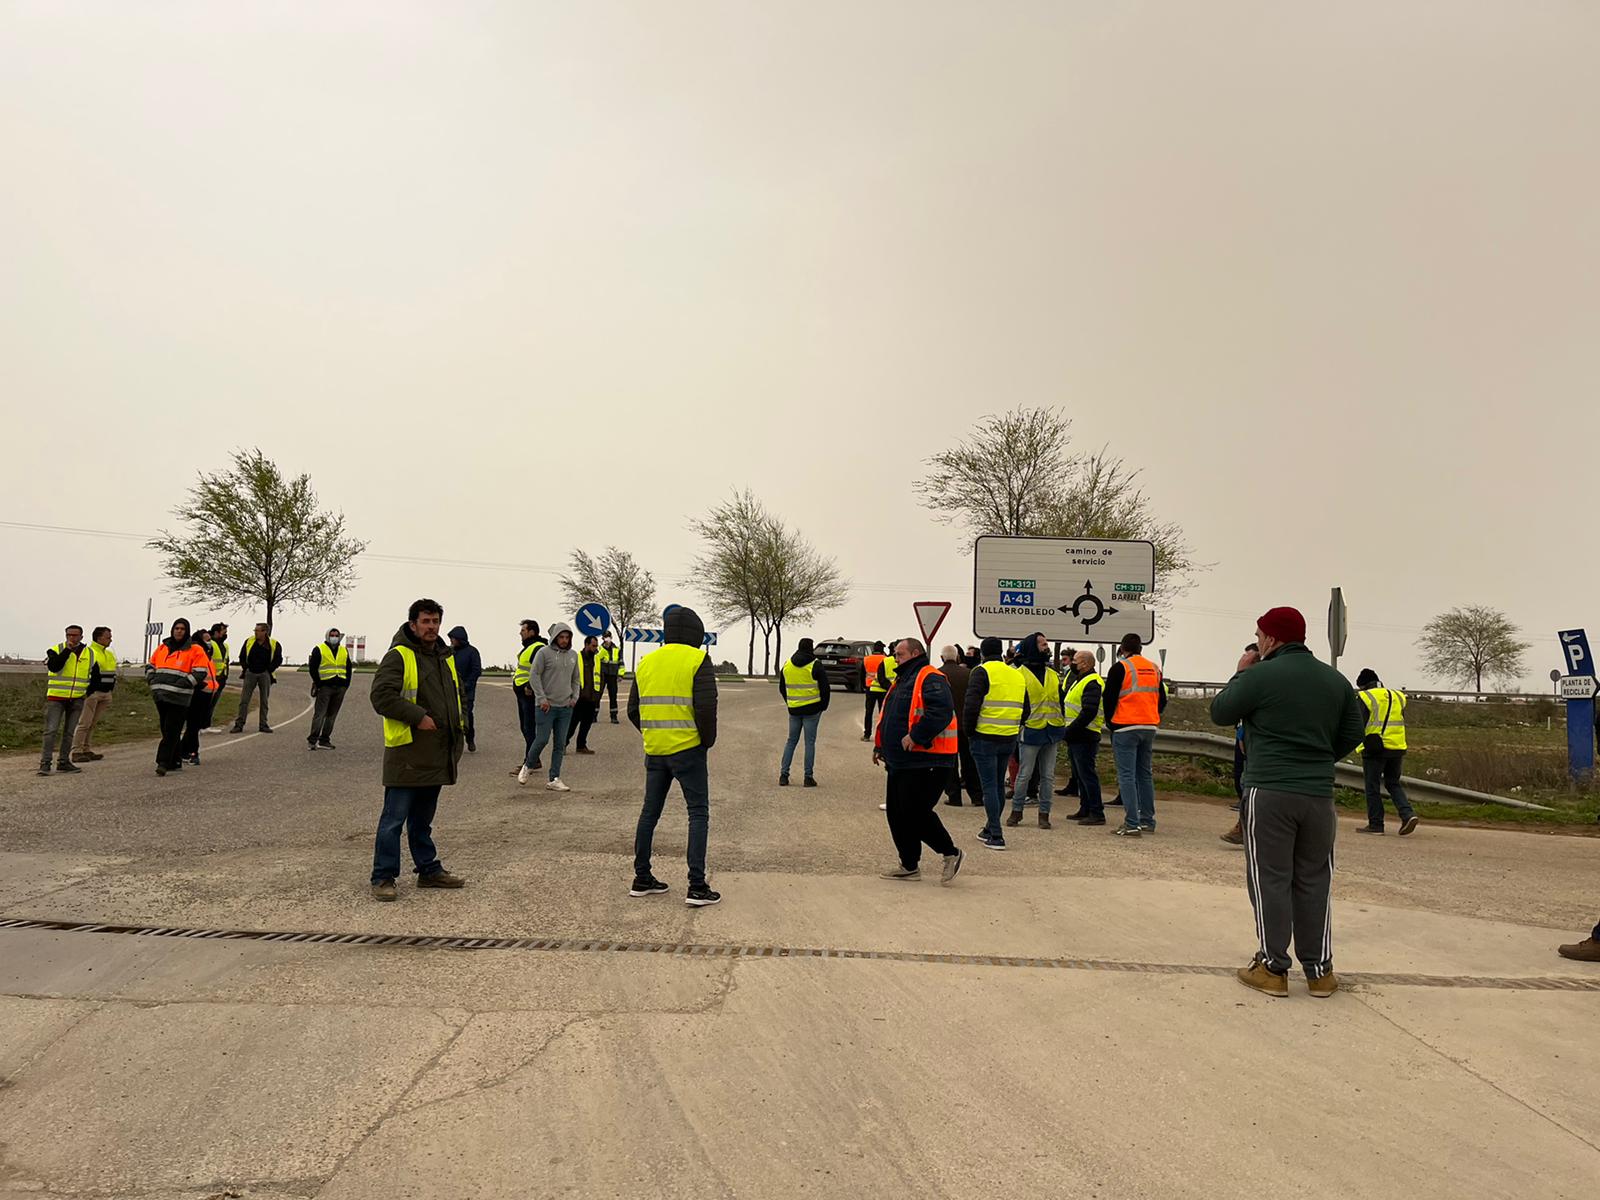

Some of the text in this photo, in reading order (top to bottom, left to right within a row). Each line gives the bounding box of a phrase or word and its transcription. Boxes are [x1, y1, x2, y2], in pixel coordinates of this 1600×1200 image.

[998, 580, 1036, 588] CM-3121
[1002, 594, 1032, 604] A-43
[980, 606, 1056, 616] VILLARROBLEDO
[1568, 644, 1584, 670] P
